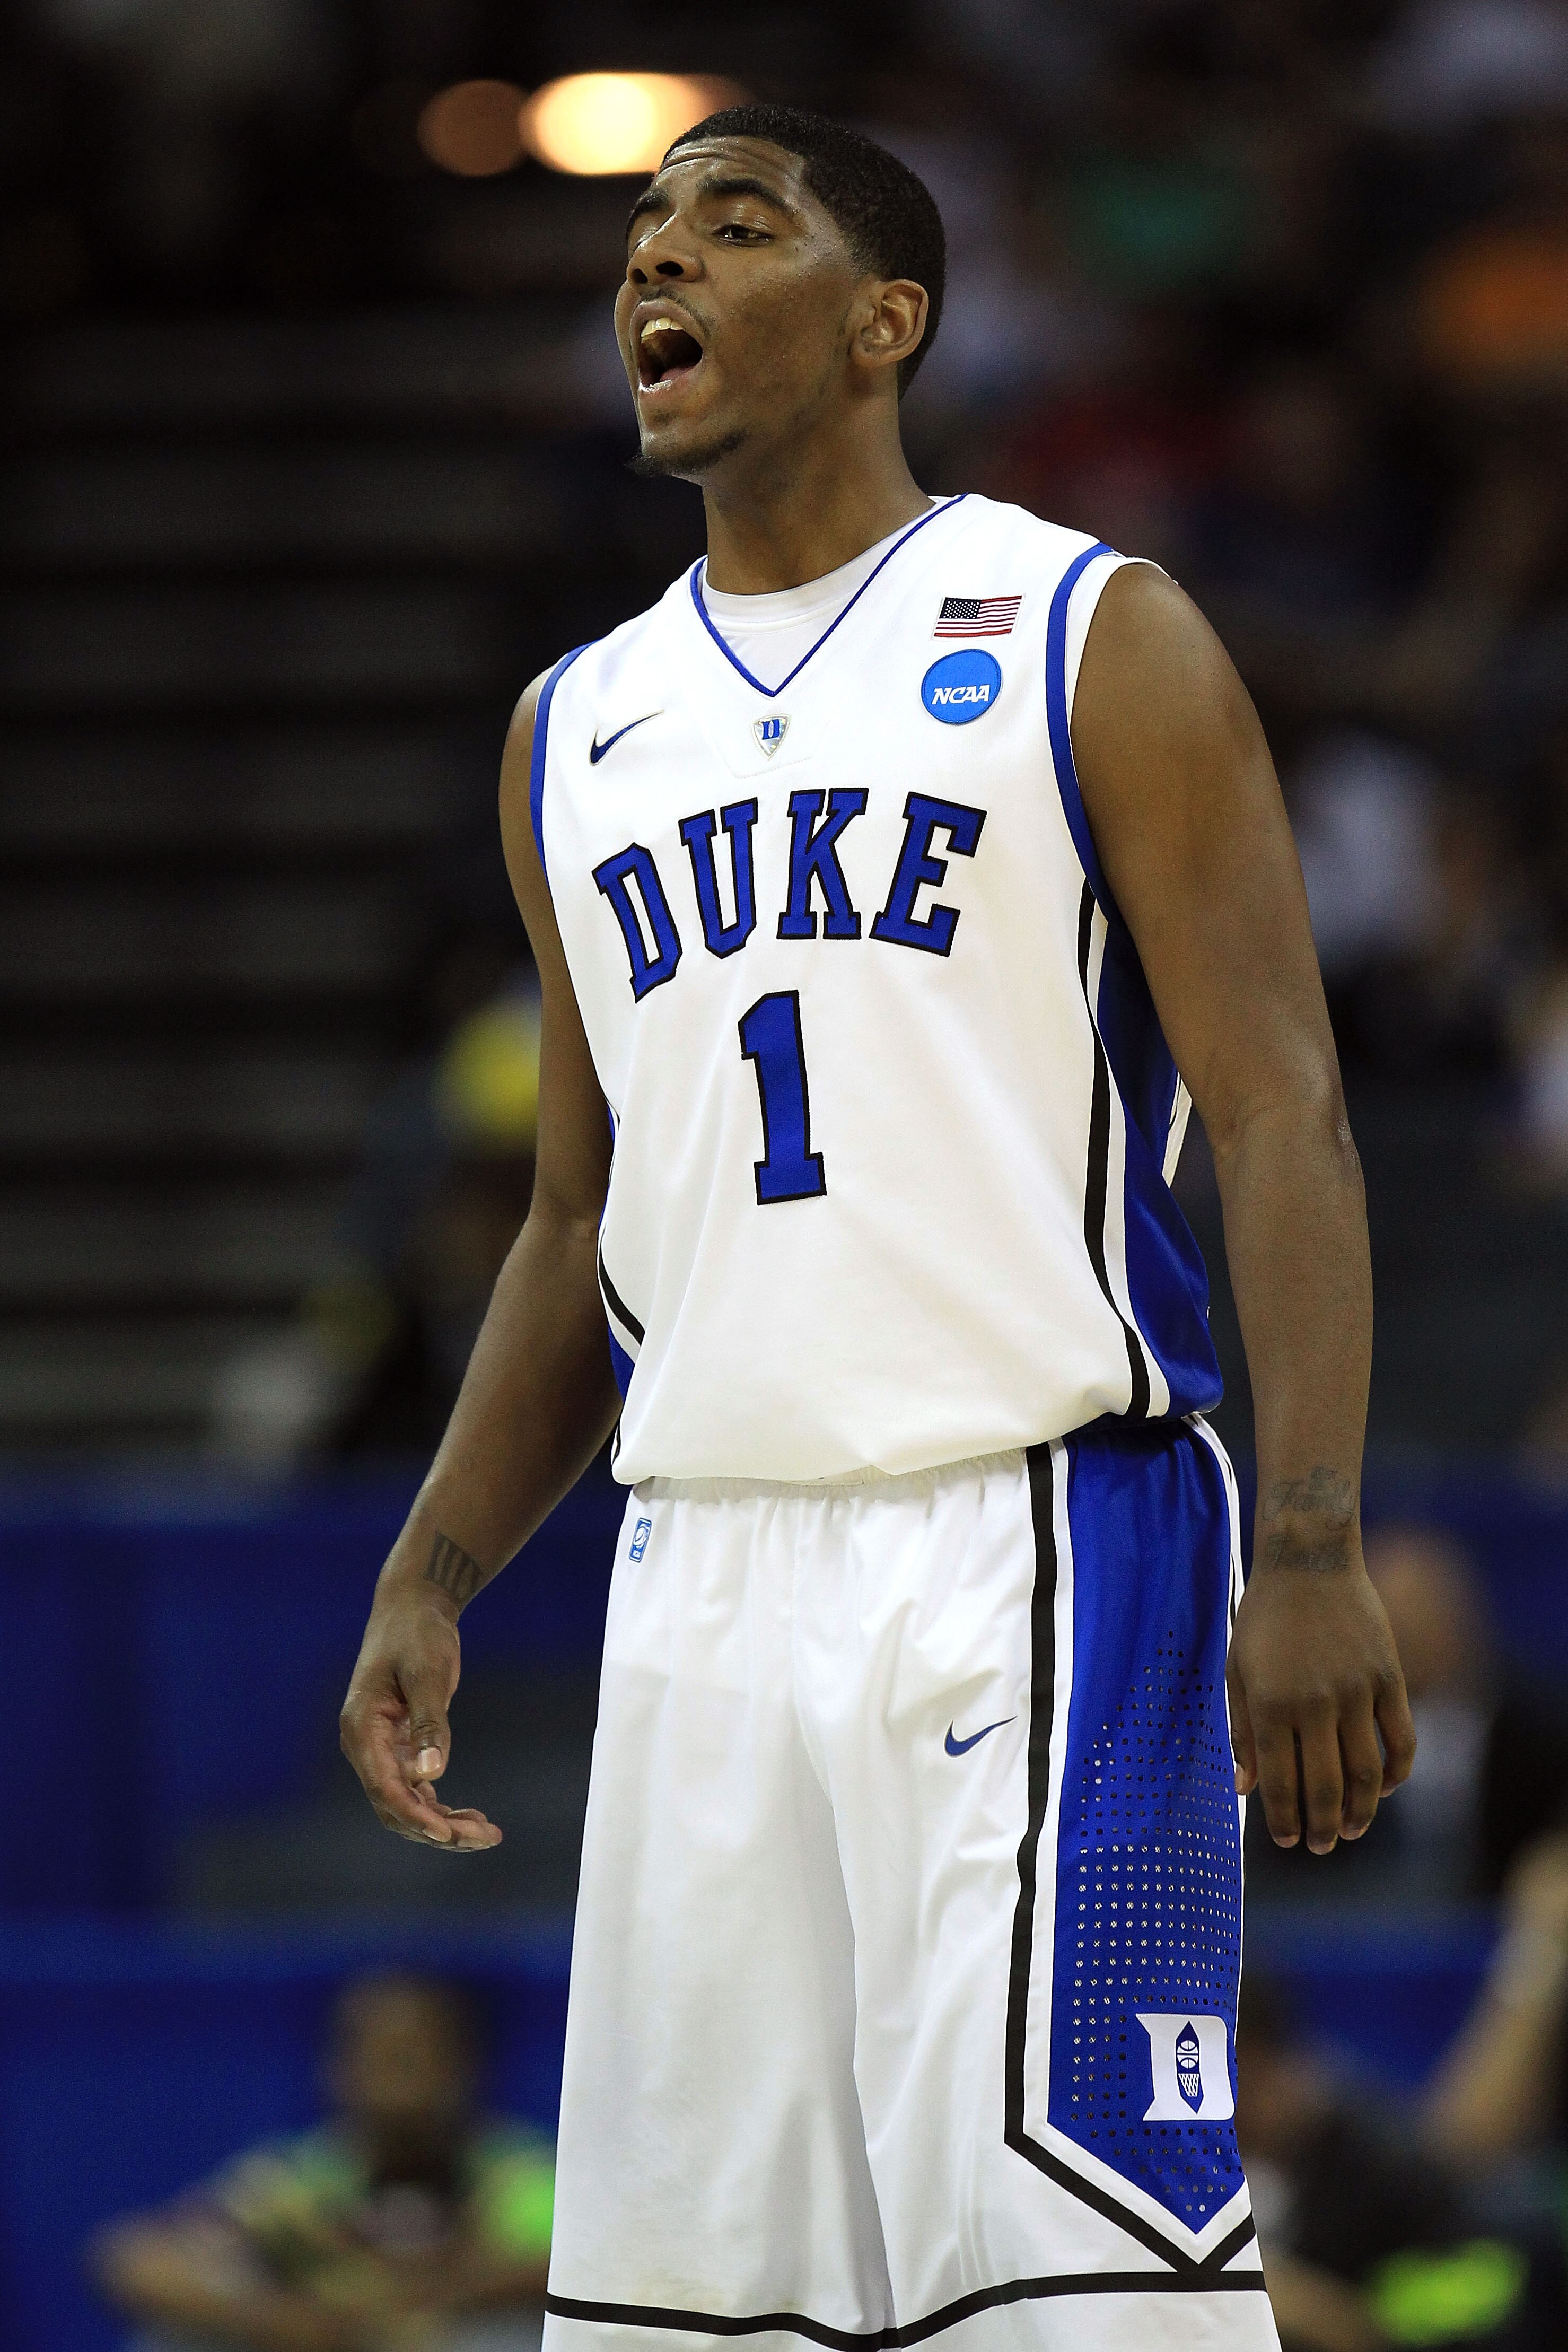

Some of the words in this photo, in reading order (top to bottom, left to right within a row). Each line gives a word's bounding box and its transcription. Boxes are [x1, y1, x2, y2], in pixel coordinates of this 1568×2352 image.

[932, 684, 990, 704] NCAA
[591, 788, 987, 1003] DUKE
[738, 990, 827, 1205] 1
